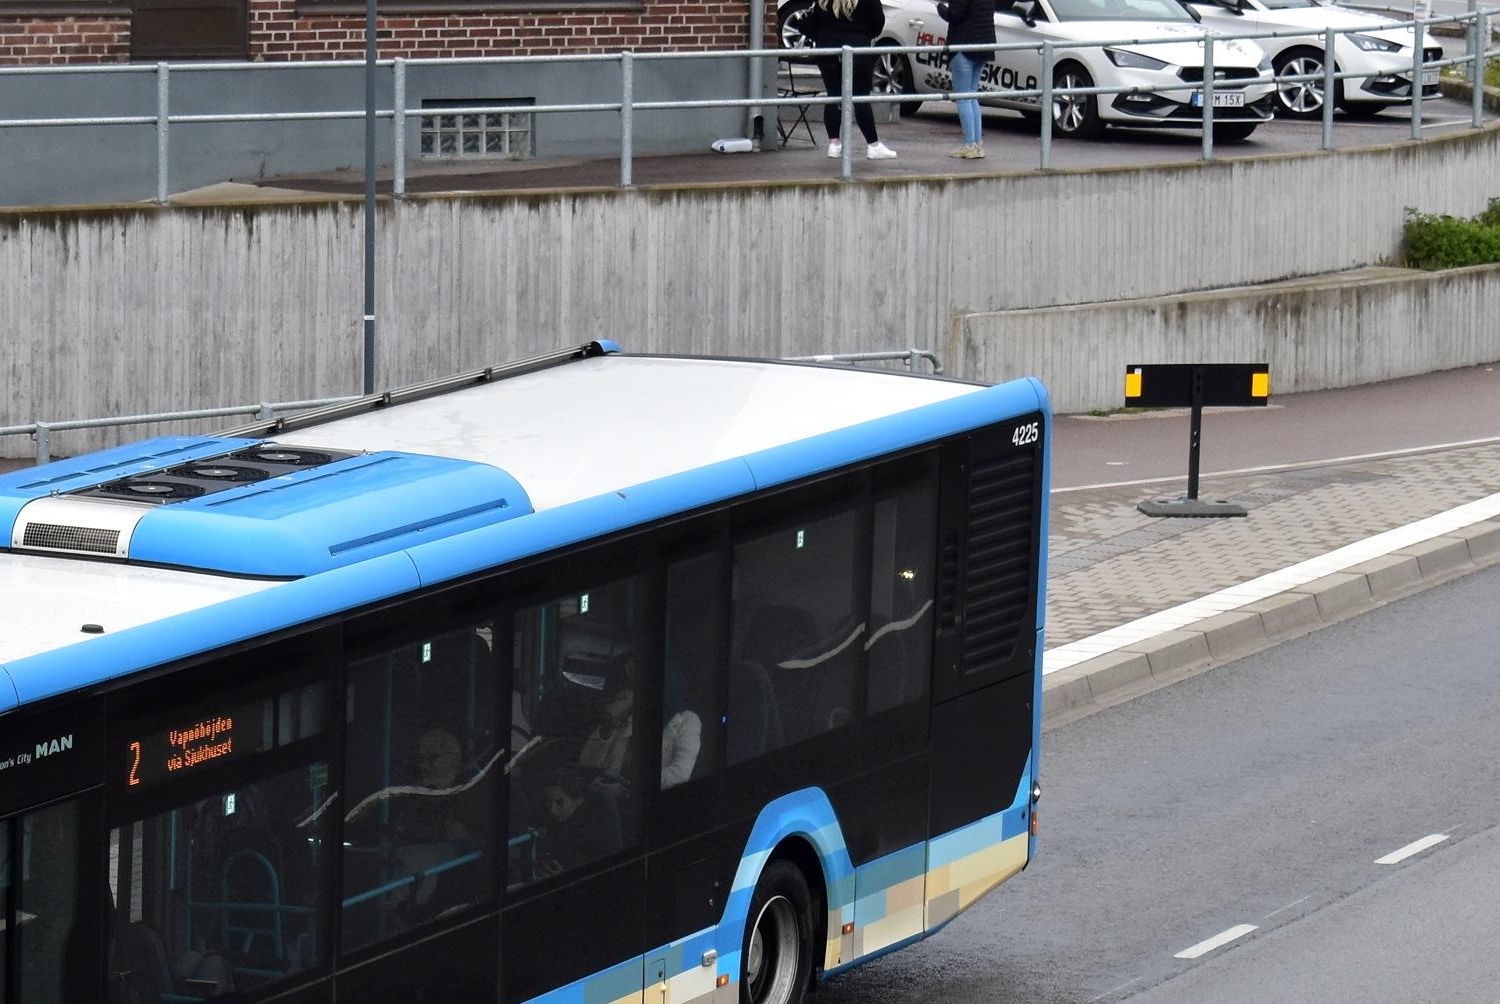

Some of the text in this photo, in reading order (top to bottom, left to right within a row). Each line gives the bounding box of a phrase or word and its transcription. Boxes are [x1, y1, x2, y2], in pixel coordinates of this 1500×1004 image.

[1012, 422, 1039, 446] 4225
[17, 753, 32, 764] City
[35, 734, 73, 759] MAN
[167, 737, 232, 771] via Sjukhuset
[129, 742, 140, 786] 2
